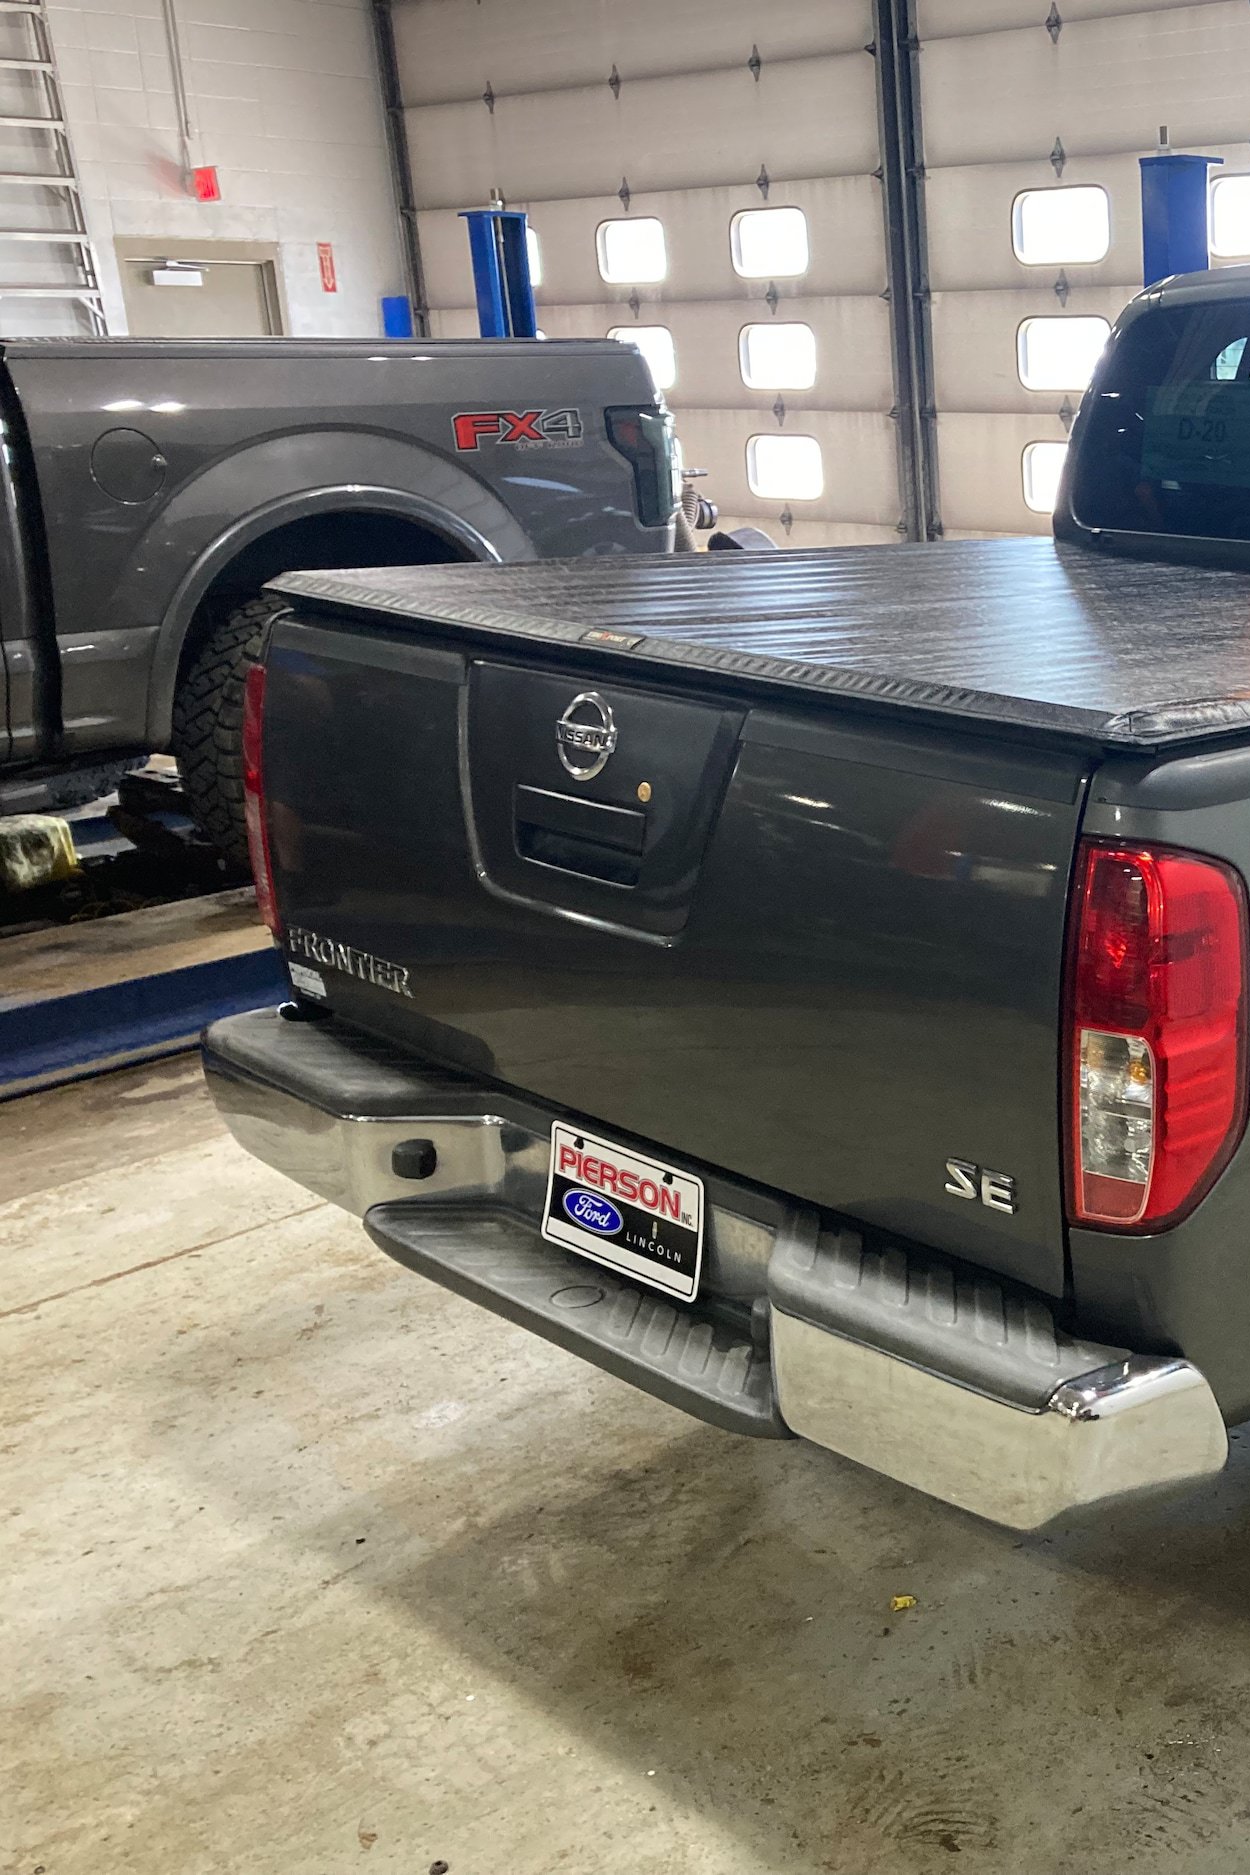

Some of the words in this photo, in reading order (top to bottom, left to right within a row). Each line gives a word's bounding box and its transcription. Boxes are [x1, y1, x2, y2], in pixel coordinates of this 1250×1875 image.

[451, 408, 584, 452] FX4
[556, 723, 606, 749] NISSAN
[286, 926, 415, 999] FRONTIER
[558, 1143, 683, 1221] PIERSON
[944, 1157, 1015, 1215] SE
[573, 1194, 611, 1229] Ford
[626, 1231, 682, 1264] LINCOLN
